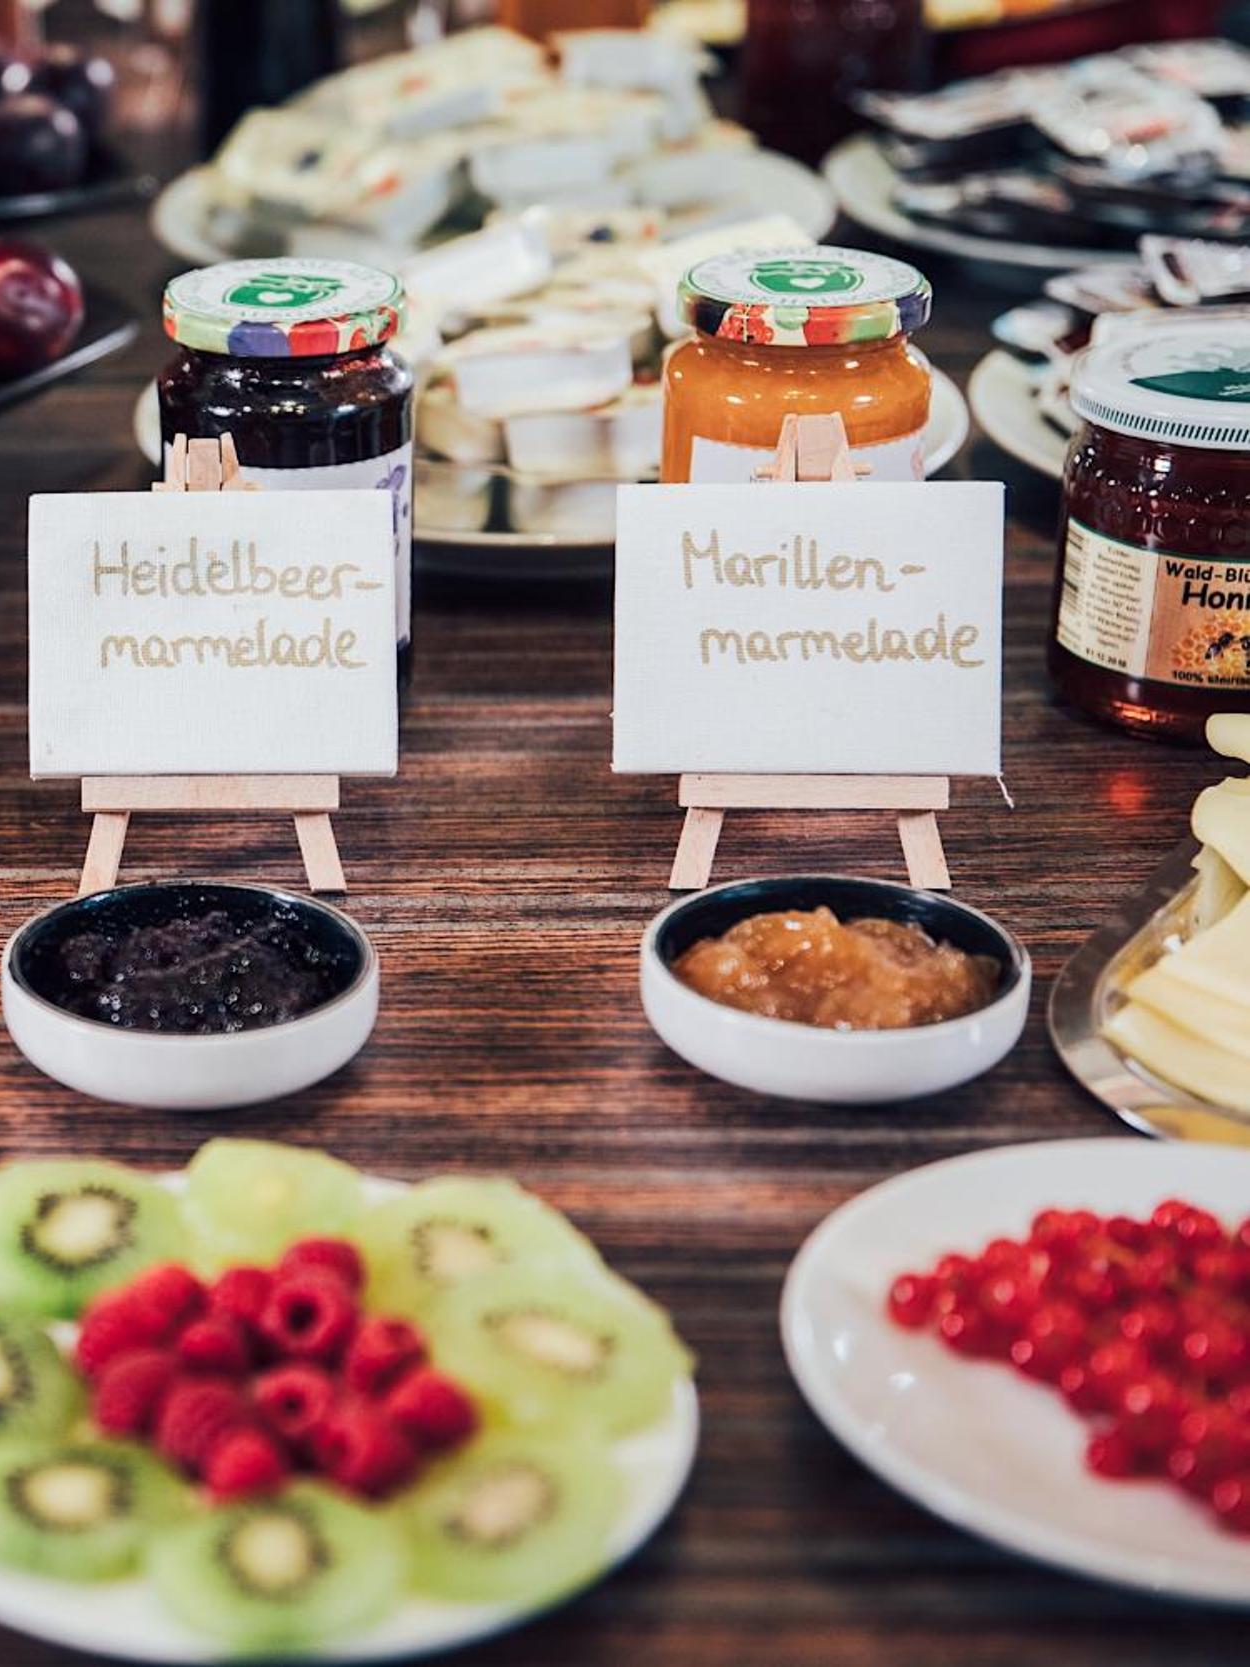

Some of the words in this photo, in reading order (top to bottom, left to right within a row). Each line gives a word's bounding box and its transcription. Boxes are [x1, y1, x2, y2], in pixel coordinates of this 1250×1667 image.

[93, 536, 385, 599] Heidelbeer-
[681, 530, 926, 592] Marillen-
[99, 618, 368, 669] marmelade
[701, 614, 985, 668] marmelade
[1173, 670, 1204, 683] 100%
